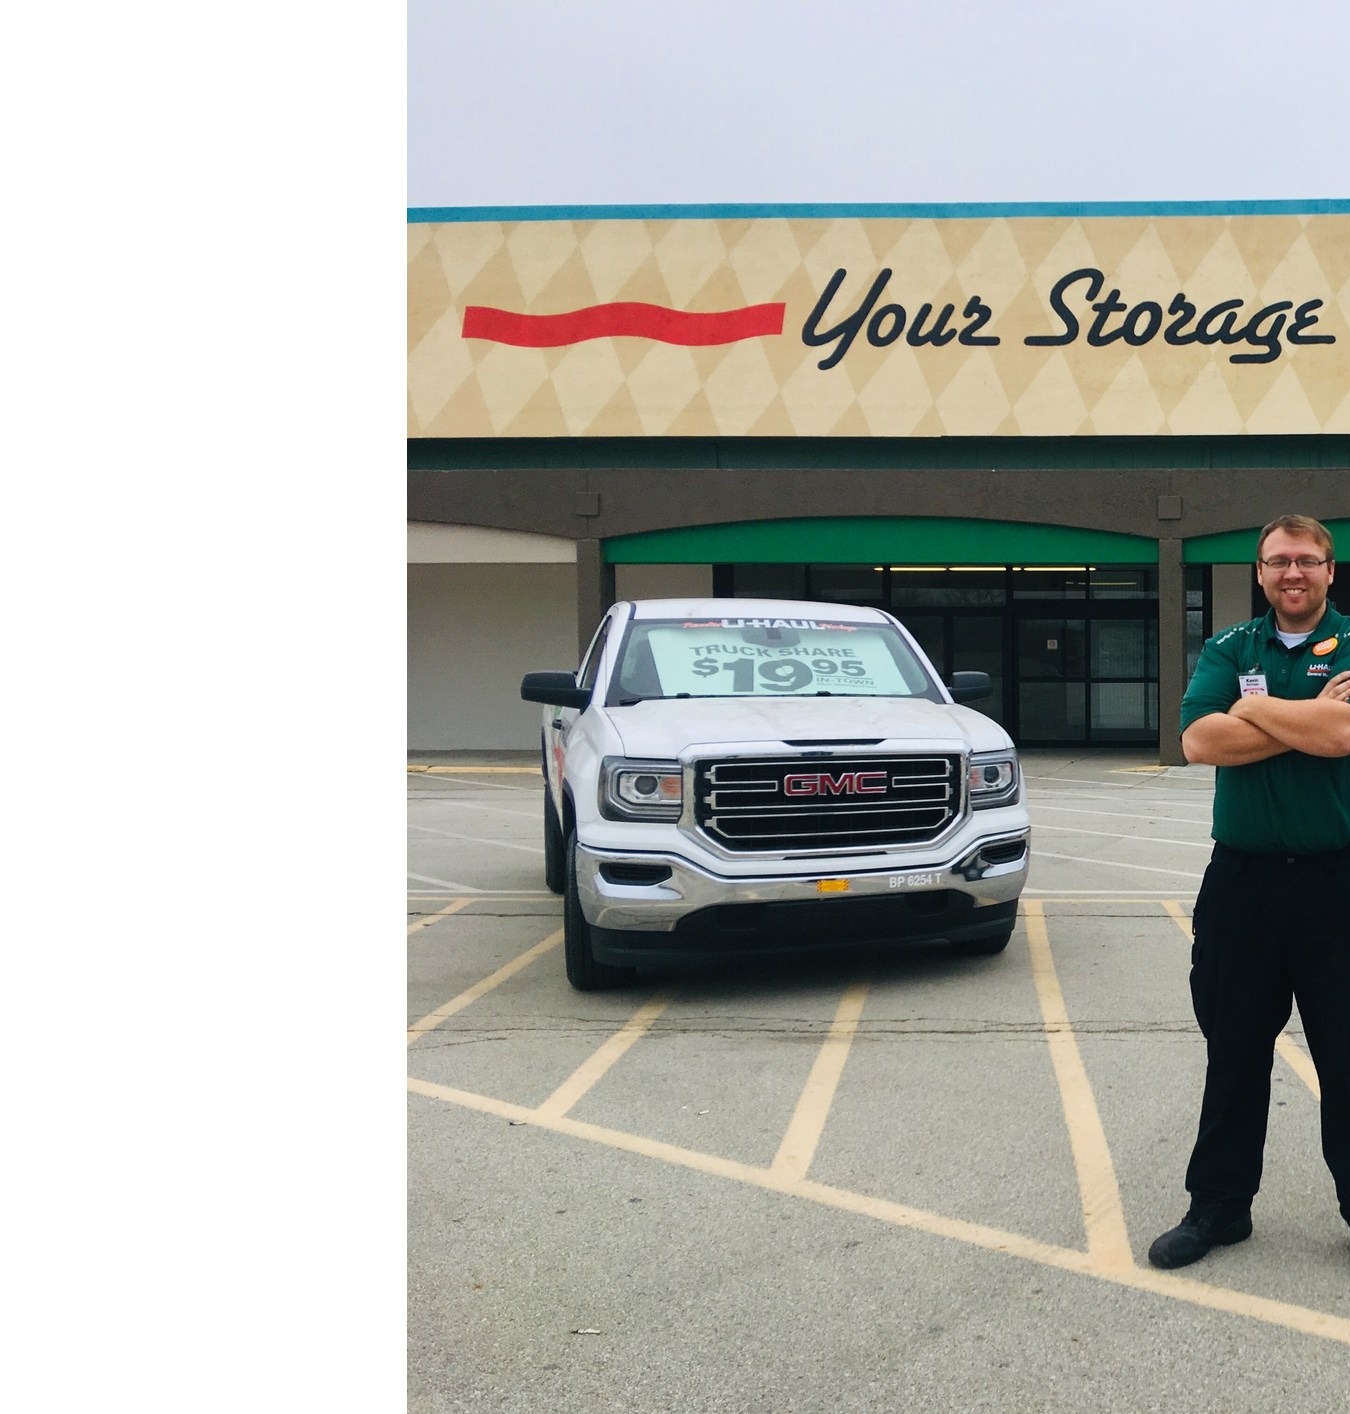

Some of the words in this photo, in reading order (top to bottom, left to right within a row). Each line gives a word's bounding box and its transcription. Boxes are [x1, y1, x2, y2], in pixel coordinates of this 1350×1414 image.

[801, 268, 1000, 370] Your
[1024, 268, 1336, 364] Storage
[721, 619, 825, 630] U-HAUL
[689, 644, 774, 657] TRUCK
[778, 647, 857, 658] SHARE
[816, 677, 875, 686] IN-TOWN
[784, 771, 887, 797] GMC
[889, 877, 904, 888] BP
[907, 874, 932, 887] 6254
[934, 873, 942, 883] T
